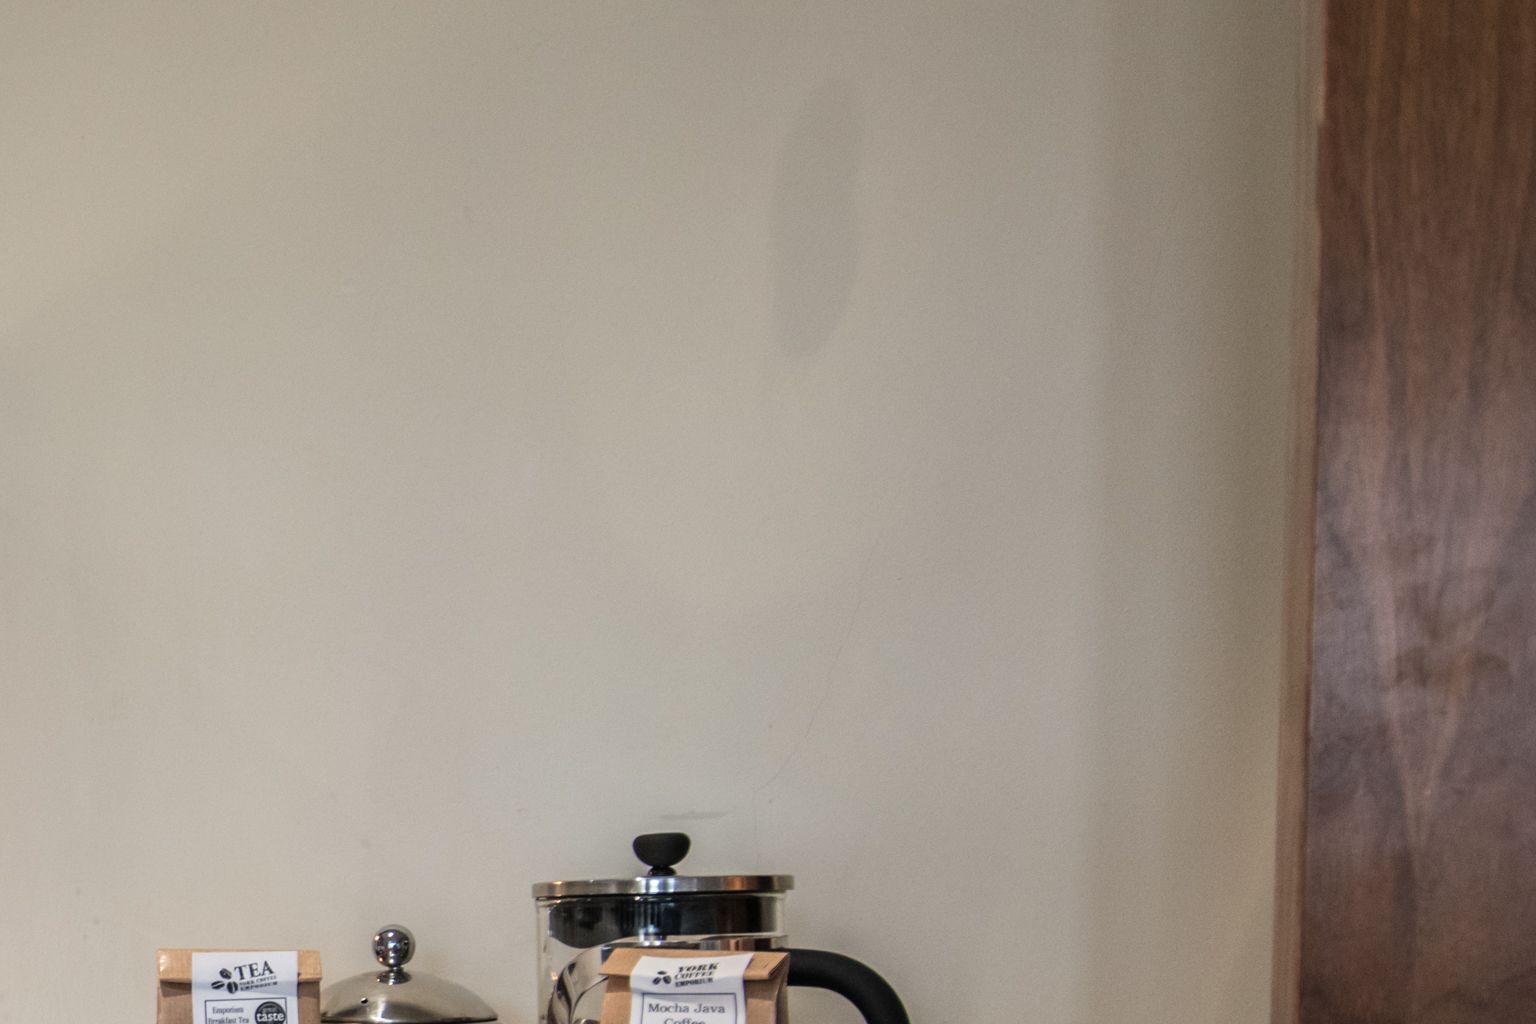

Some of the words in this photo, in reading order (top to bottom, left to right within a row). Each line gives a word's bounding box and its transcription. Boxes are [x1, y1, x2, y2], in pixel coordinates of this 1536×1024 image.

[234, 960, 274, 981] TEA
[677, 962, 719, 973] YORK
[674, 971, 714, 981] COFFEE
[648, 1003, 690, 1014] Mocha
[693, 1003, 726, 1014] Java
[238, 1016, 250, 1024] Tea
[256, 1012, 285, 1022] taste
